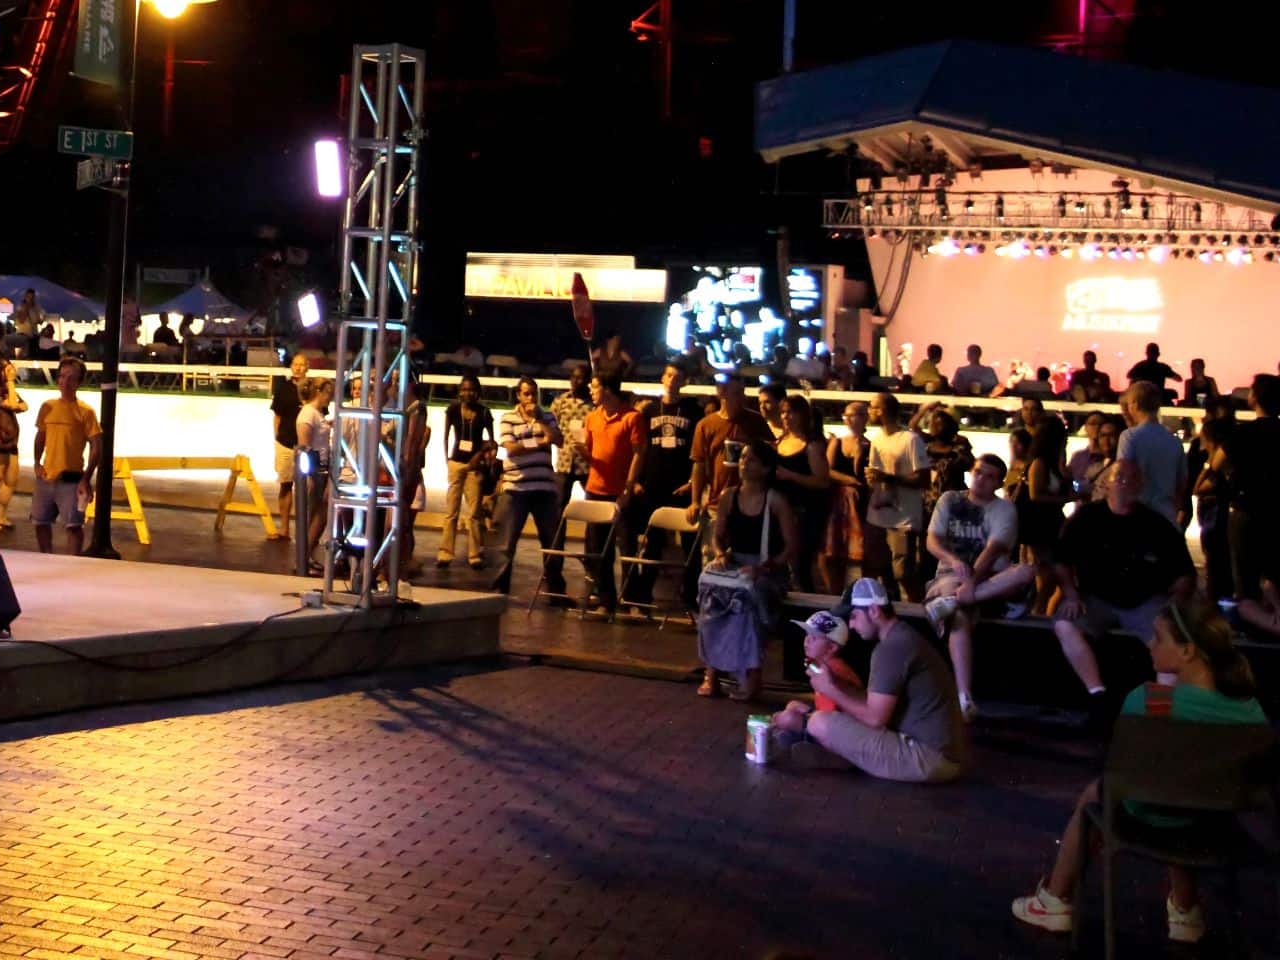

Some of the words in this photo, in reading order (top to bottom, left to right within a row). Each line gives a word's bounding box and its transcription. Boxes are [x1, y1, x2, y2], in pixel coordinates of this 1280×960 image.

[63, 130, 73, 149] E
[81, 131, 98, 153] 1ST
[104, 134, 119, 150] ST
